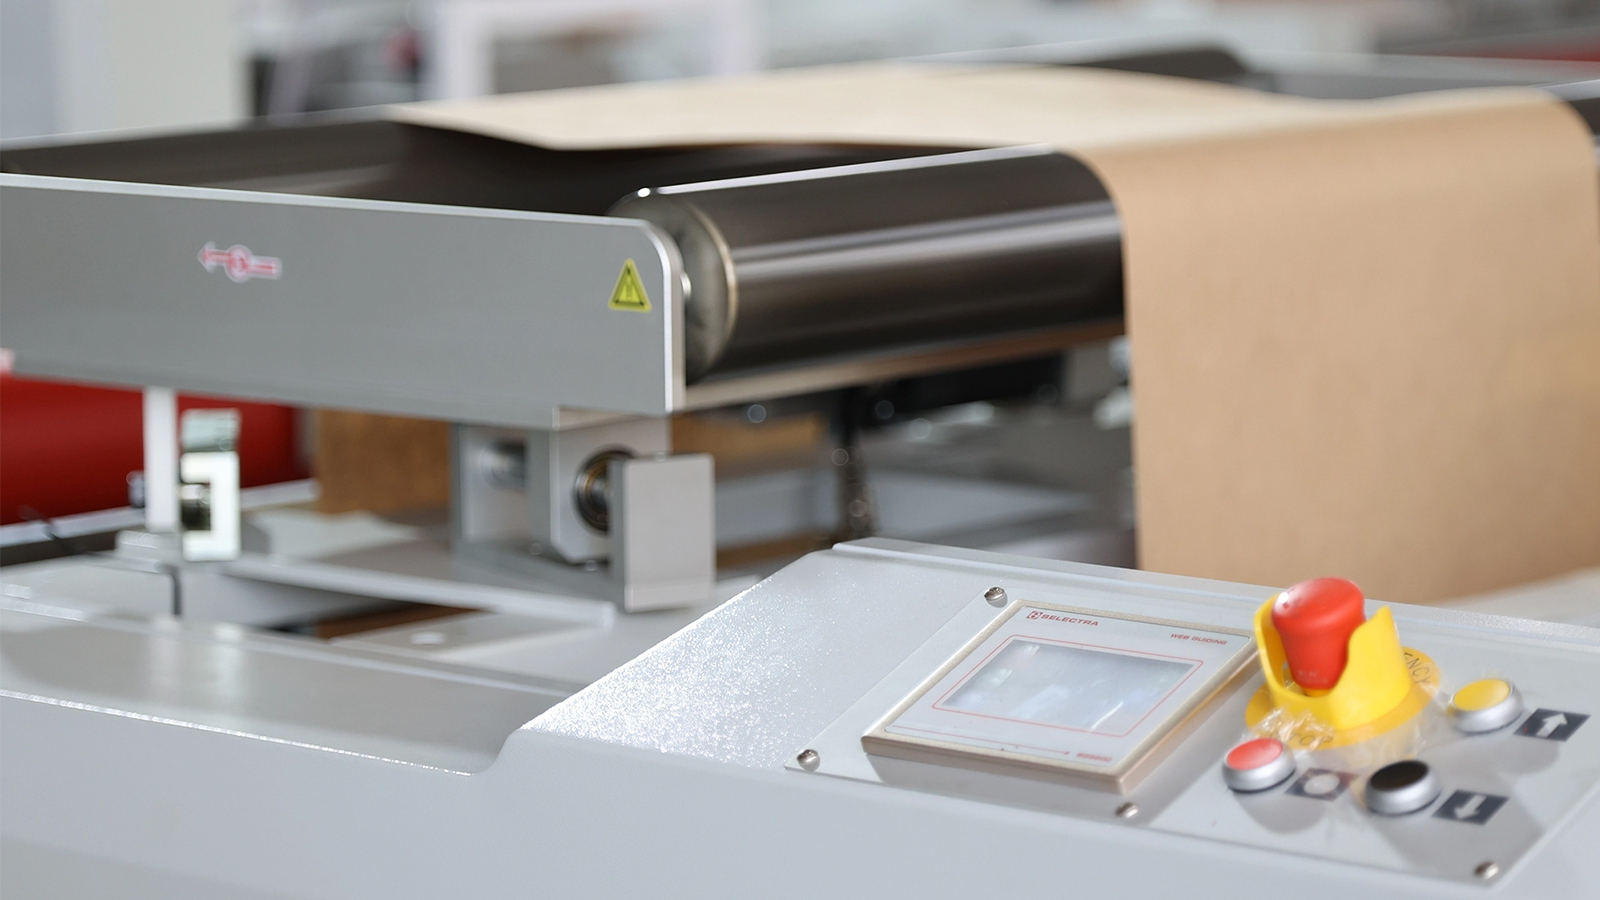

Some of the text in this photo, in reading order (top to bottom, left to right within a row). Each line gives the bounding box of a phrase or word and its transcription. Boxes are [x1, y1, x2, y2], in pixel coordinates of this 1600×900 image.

[1041, 614, 1099, 626] SELECTRA
[1191, 636, 1228, 645] GUIDING
[1270, 731, 1334, 746] TOP
